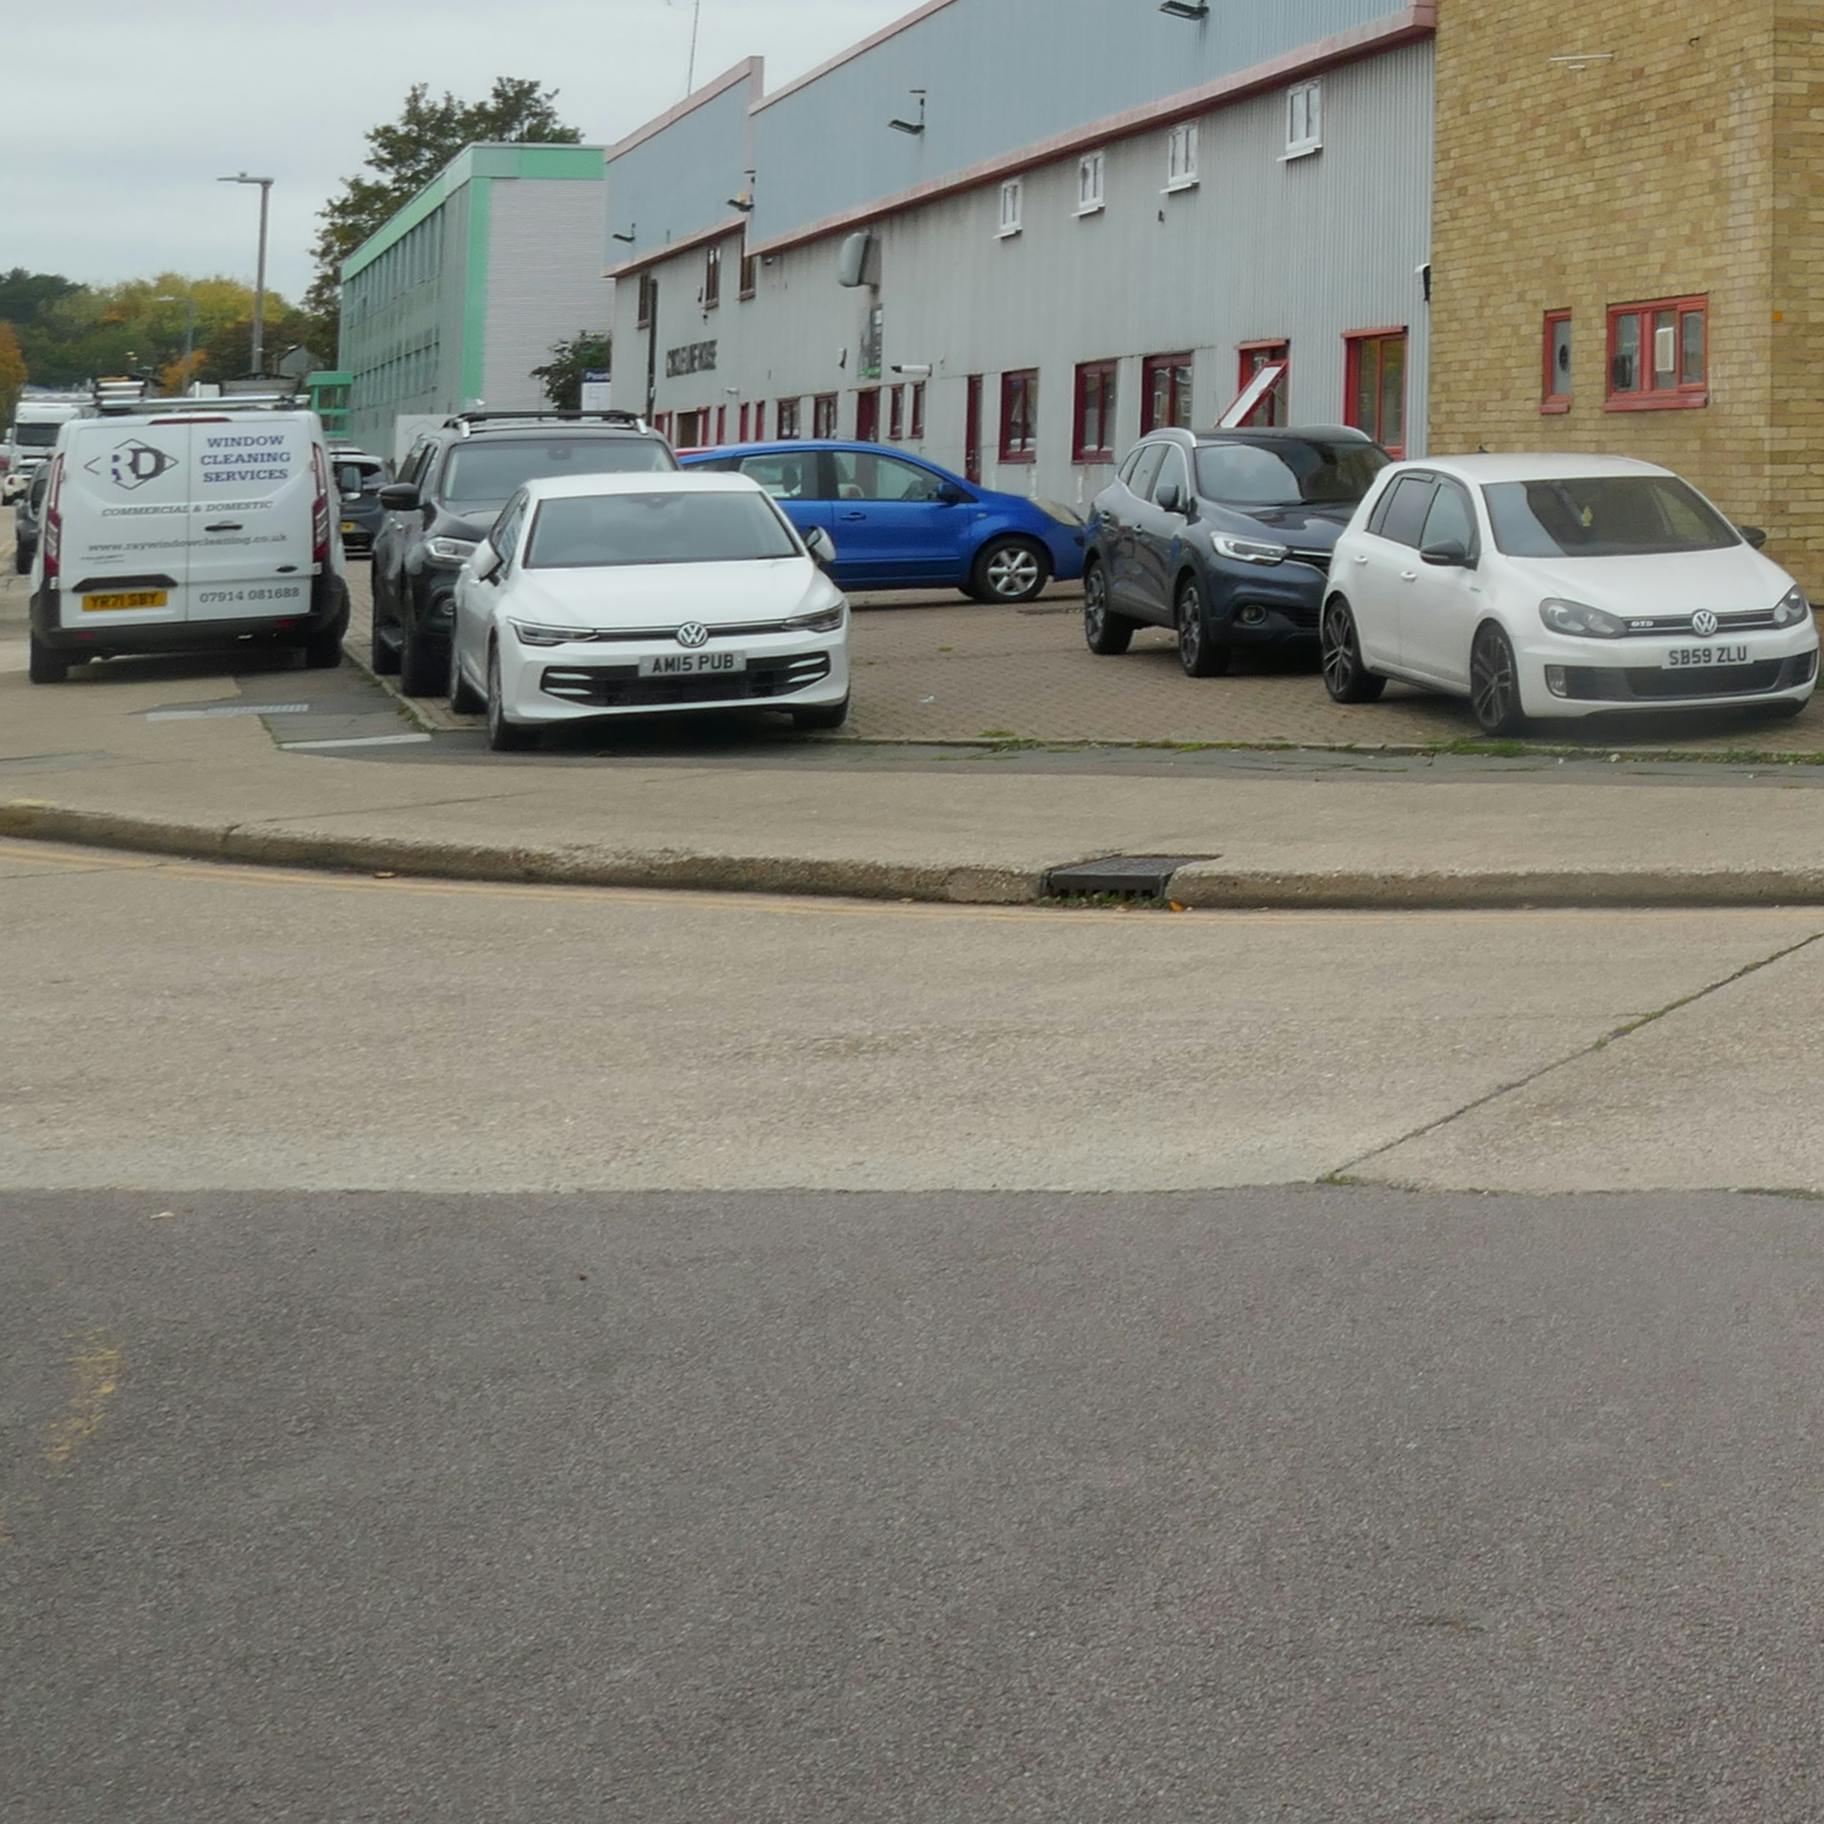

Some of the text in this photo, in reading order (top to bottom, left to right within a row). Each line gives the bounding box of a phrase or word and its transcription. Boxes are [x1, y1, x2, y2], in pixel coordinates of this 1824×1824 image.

[207, 435, 285, 448] WINDOW
[200, 452, 291, 466] CLEANING
[203, 469, 289, 483] SERVICES
[101, 504, 190, 517] COMMERCIAL
[205, 501, 274, 513] DOMESTIC
[88, 534, 287, 552] www.raywindowcleaning.co.uk
[199, 591, 244, 603] 07914
[652, 654, 734, 673] AM15 PUB
[1669, 646, 1747, 666] SB59 ZLU
